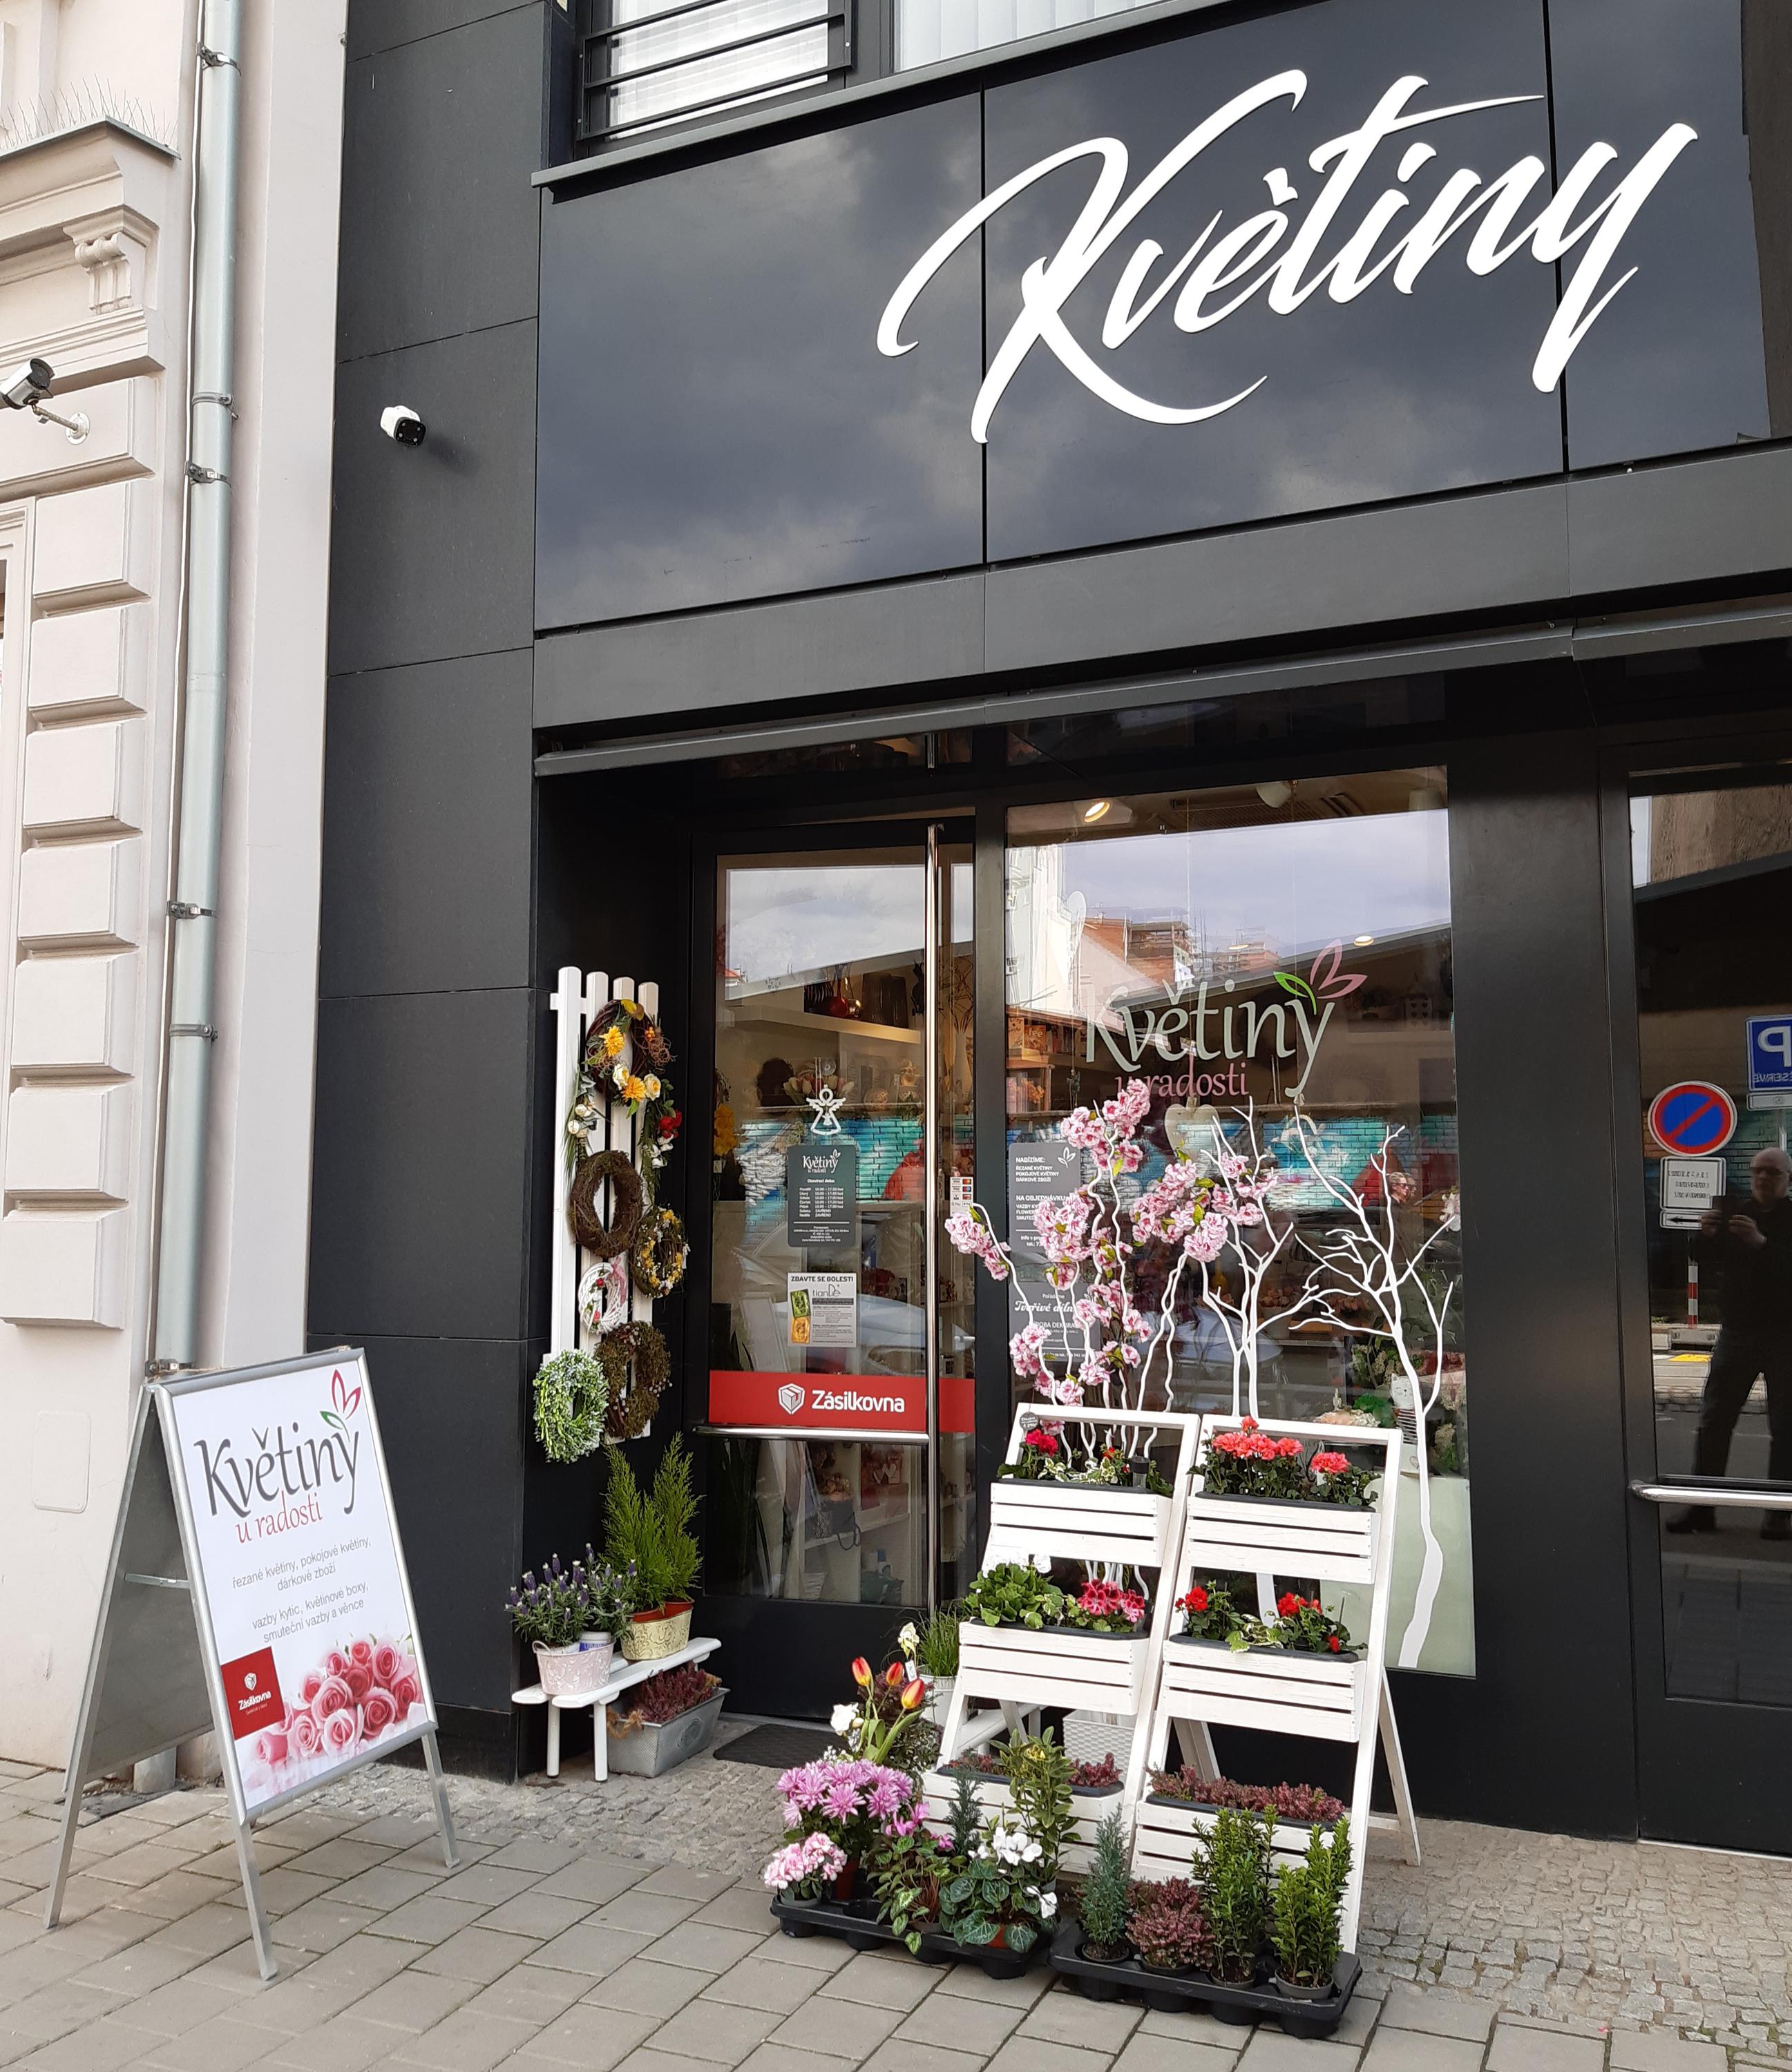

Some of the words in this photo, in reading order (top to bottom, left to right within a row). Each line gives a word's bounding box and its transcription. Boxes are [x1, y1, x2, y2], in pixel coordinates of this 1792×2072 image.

[877, 69, 1699, 443] Květiny
[1085, 978, 1335, 1098] Květiny
[1144, 1053, 1250, 1098] radosti
[802, 1155, 839, 1173] Květiny
[1014, 1300, 1051, 1312] Tvřivé
[812, 1390, 905, 1413] Zásilkovna
[193, 1421, 359, 1518] Květiny
[235, 1522, 252, 1544] u
[254, 1490, 323, 1538] radosti
[232, 1569, 264, 1589] řezané
[265, 1560, 298, 1578] květiny,
[300, 1544, 339, 1568] pokojové
[340, 1536, 372, 1554] květiny,
[277, 1571, 312, 1591] dárkové
[314, 1561, 336, 1579] zboží
[252, 1611, 277, 1630] vazby
[278, 1604, 303, 1622] kytic,
[305, 1587, 345, 1611] květinové
[346, 1581, 369, 1596] boxy,
[263, 1620, 304, 1643] smuteční
[305, 1611, 330, 1629] vazby
[332, 1609, 337, 1618] a
[338, 1599, 365, 1615] věnce
[238, 1691, 271, 1711] Zásilkovna
